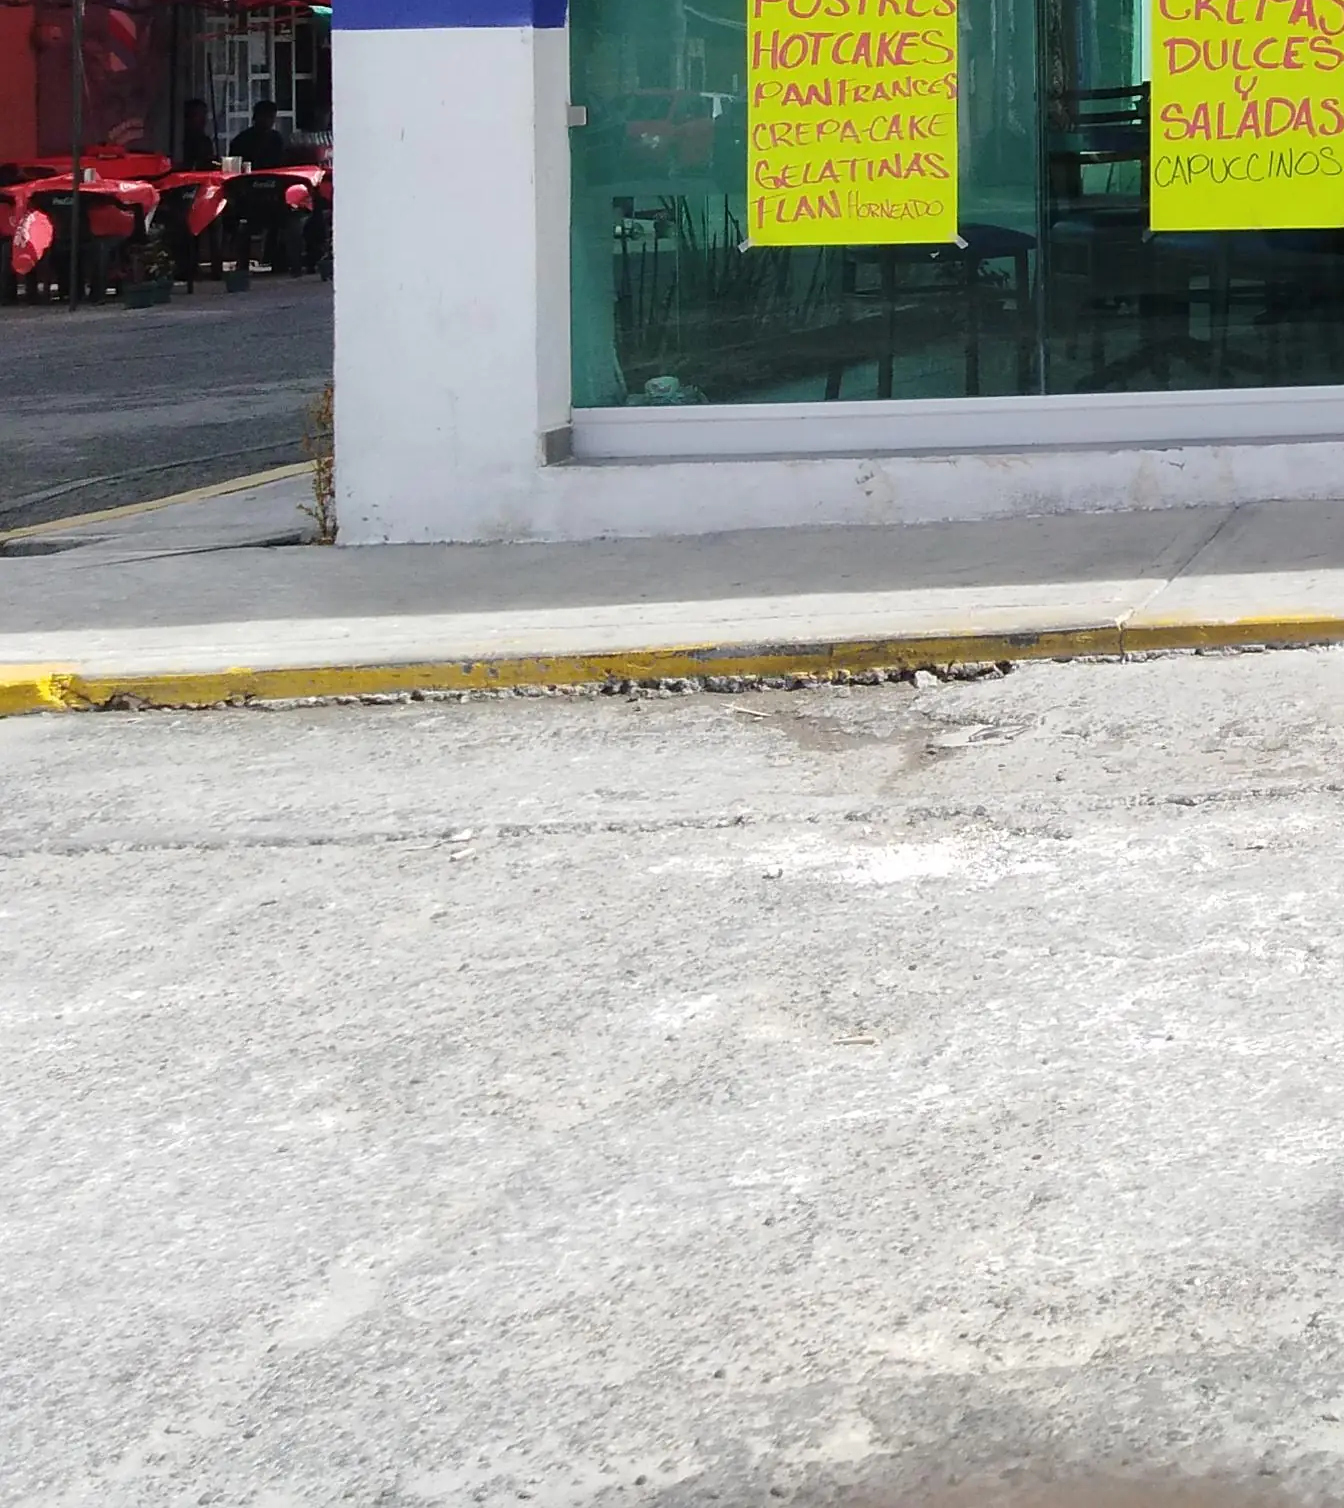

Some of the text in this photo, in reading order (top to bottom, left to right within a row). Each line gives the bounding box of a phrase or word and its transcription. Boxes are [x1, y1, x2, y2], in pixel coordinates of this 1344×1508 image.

[754, 78, 833, 108] PAN
[755, 151, 950, 191] GELATINAS
[1154, 146, 1343, 188] CAPUCCINOS
[751, 189, 843, 230] FLAN
